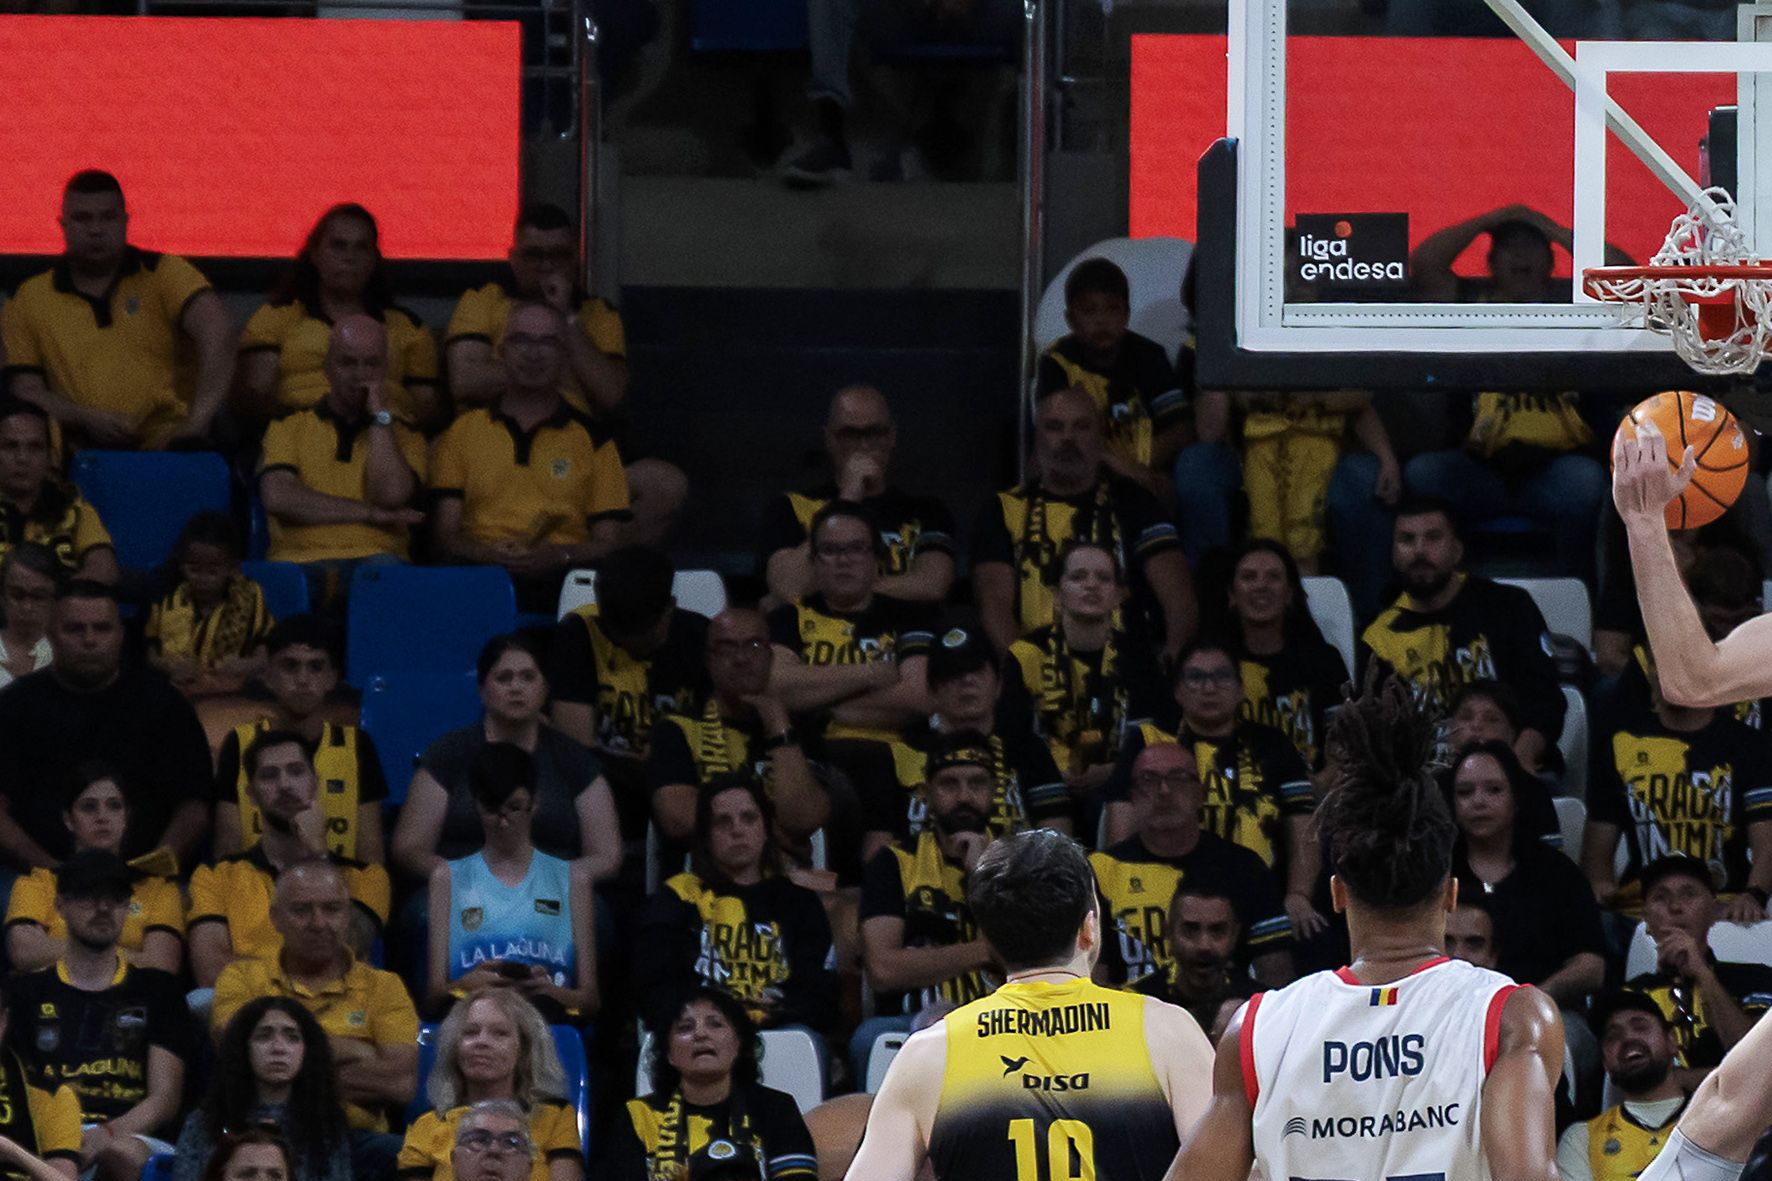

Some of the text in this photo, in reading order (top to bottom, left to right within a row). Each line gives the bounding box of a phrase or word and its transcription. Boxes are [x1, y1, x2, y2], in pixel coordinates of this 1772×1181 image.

[1300, 234, 1347, 260] liga
[1300, 258, 1403, 280] endesa
[977, 1002, 1111, 1038] SHERMADINI
[1323, 1033, 1425, 1083] PONS
[1311, 1103, 1459, 1139] MORABANC
